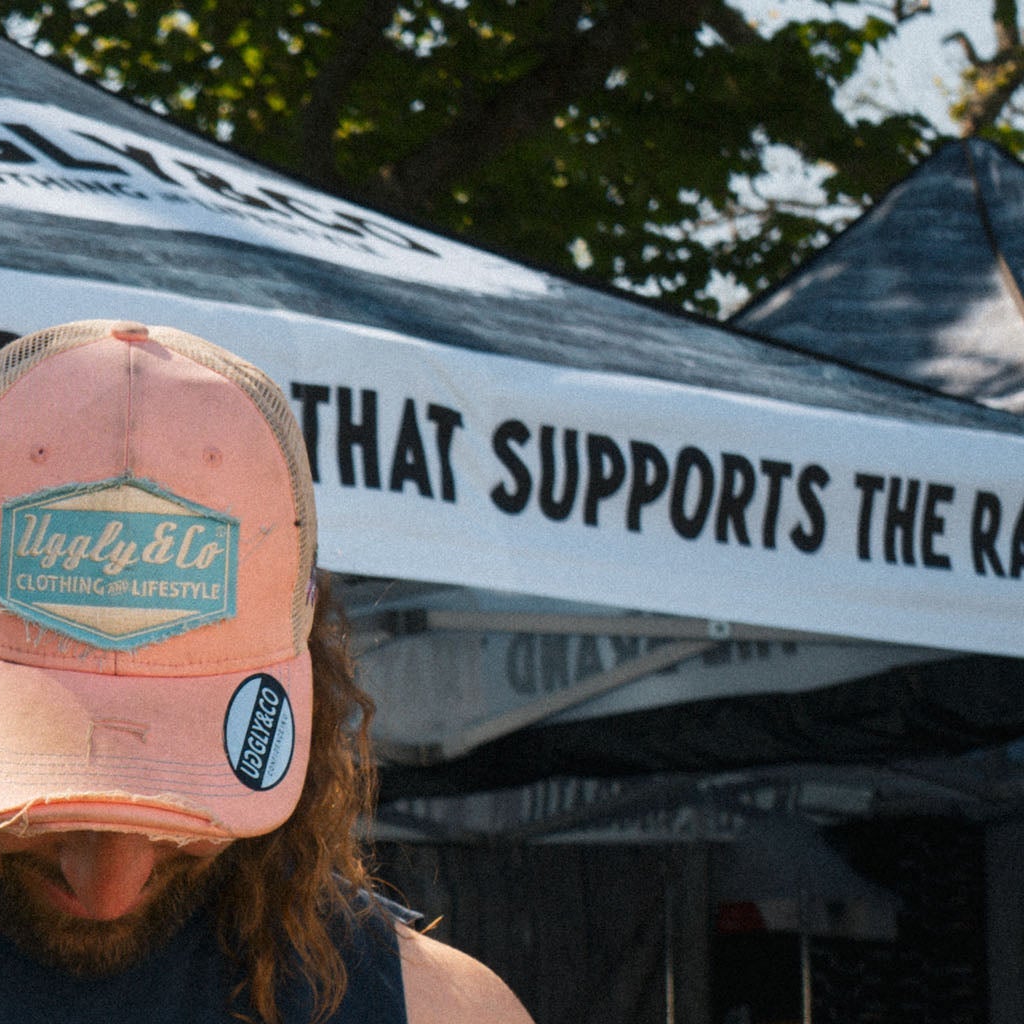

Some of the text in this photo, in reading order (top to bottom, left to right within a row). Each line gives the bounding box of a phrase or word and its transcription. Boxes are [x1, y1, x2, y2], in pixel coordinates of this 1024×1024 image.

[289, 382, 464, 504] THAT
[488, 418, 831, 555] SUPPORTS
[854, 472, 955, 571] THE
[16, 574, 105, 596] CLOTHING
[131, 579, 221, 600] LIFESTYLE
[239, 686, 280, 779] UGGLY&CO
